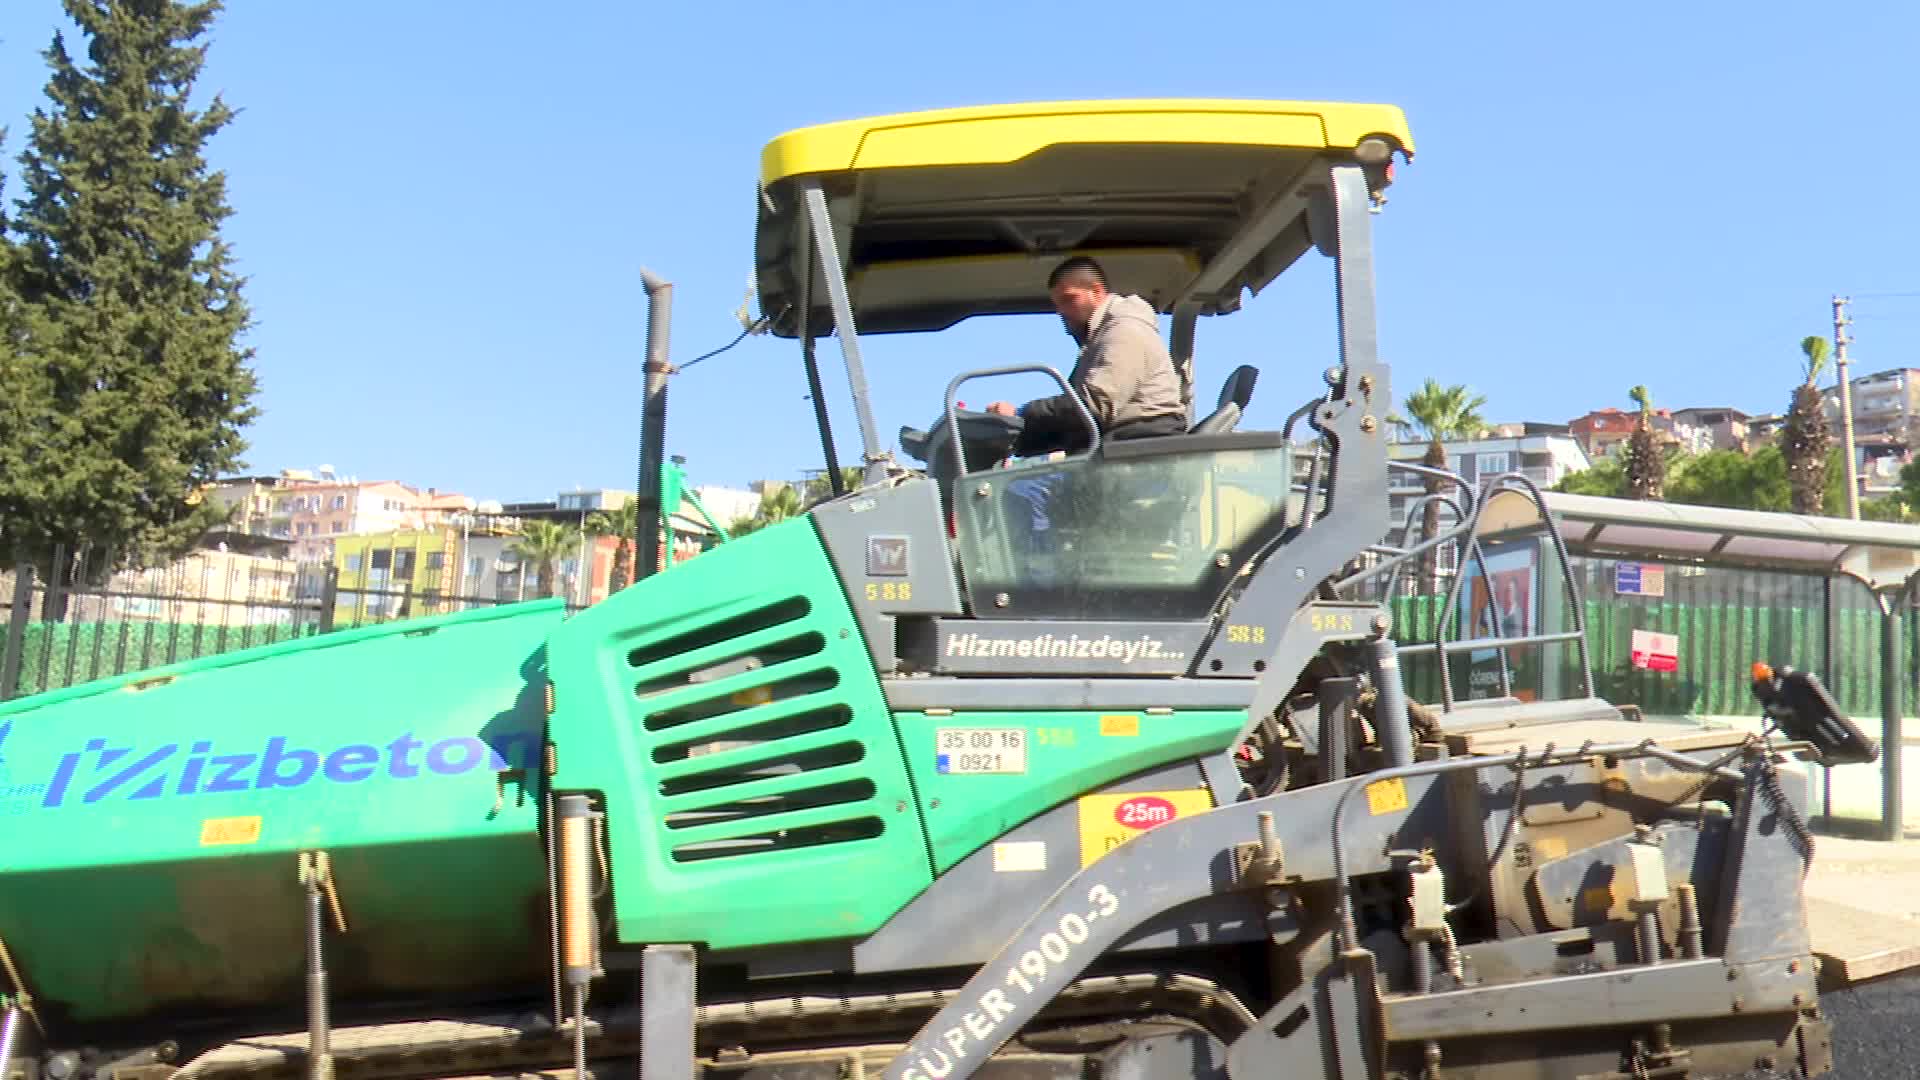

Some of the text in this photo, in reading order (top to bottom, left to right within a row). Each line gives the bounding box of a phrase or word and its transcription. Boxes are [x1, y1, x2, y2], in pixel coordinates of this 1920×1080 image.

[946, 634, 1185, 664] Hizmetinizdeyiz...
[943, 731, 965, 748] 35
[970, 731, 993, 748] 00
[1001, 731, 1020, 748] 16
[175, 730, 540, 797] izbeton
[959, 754, 1003, 770] 0921
[1121, 802, 1170, 823] 25m
[1005, 884, 1120, 995] 1900-3
